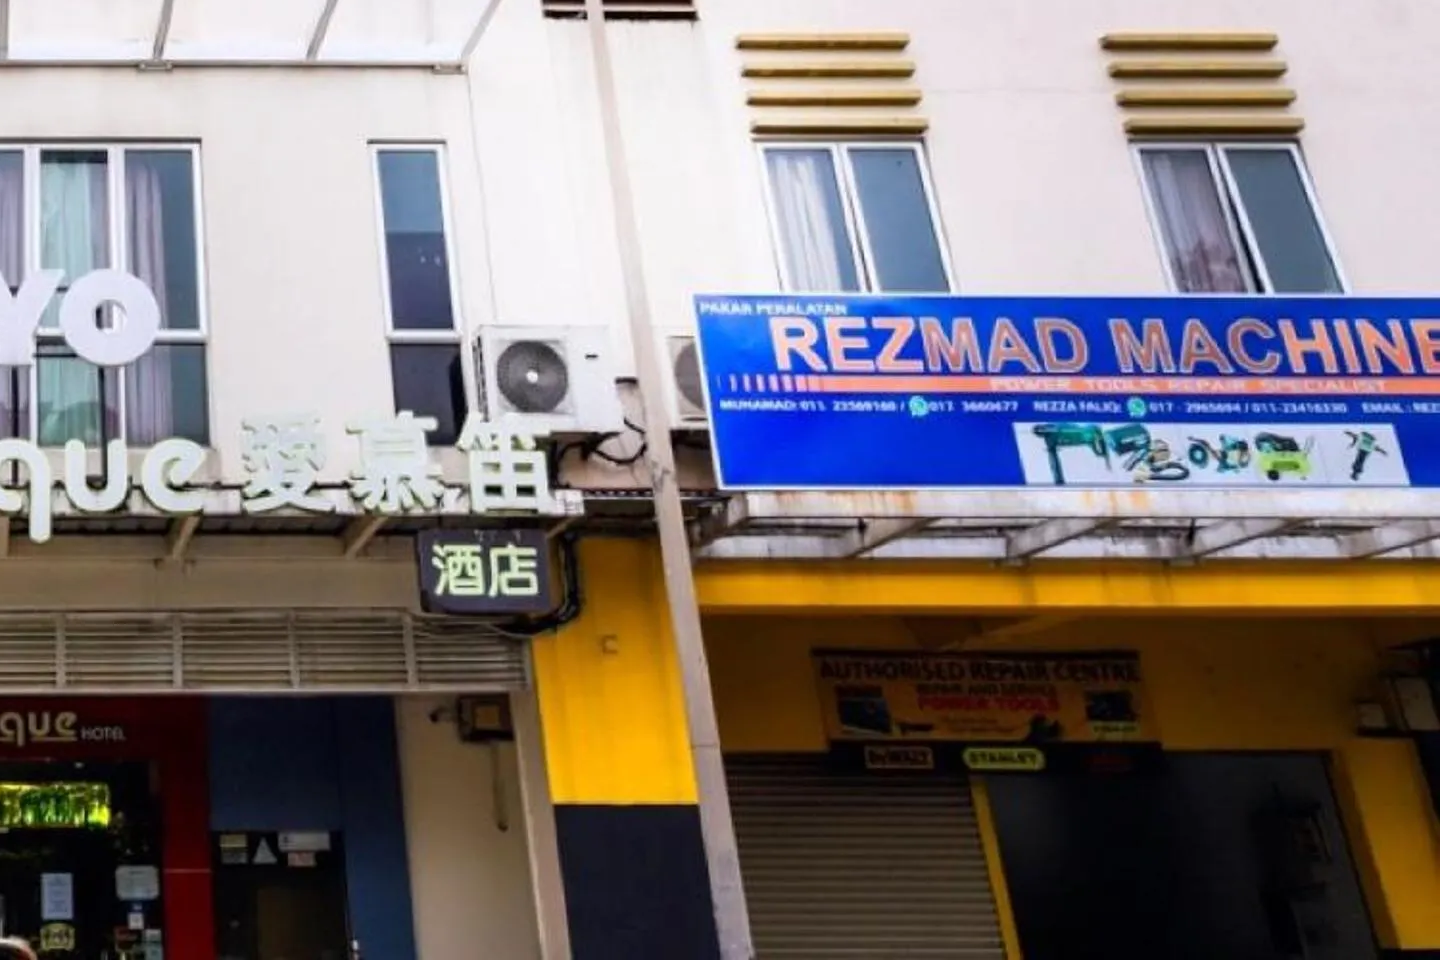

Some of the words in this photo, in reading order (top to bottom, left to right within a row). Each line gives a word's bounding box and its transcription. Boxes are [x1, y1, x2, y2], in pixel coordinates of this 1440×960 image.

[770, 316, 1088, 373] REZMAD
[990, 379, 1071, 392] POWER
[431, 544, 538, 596] 酒店
[80, 726, 127, 742] HOTEL
